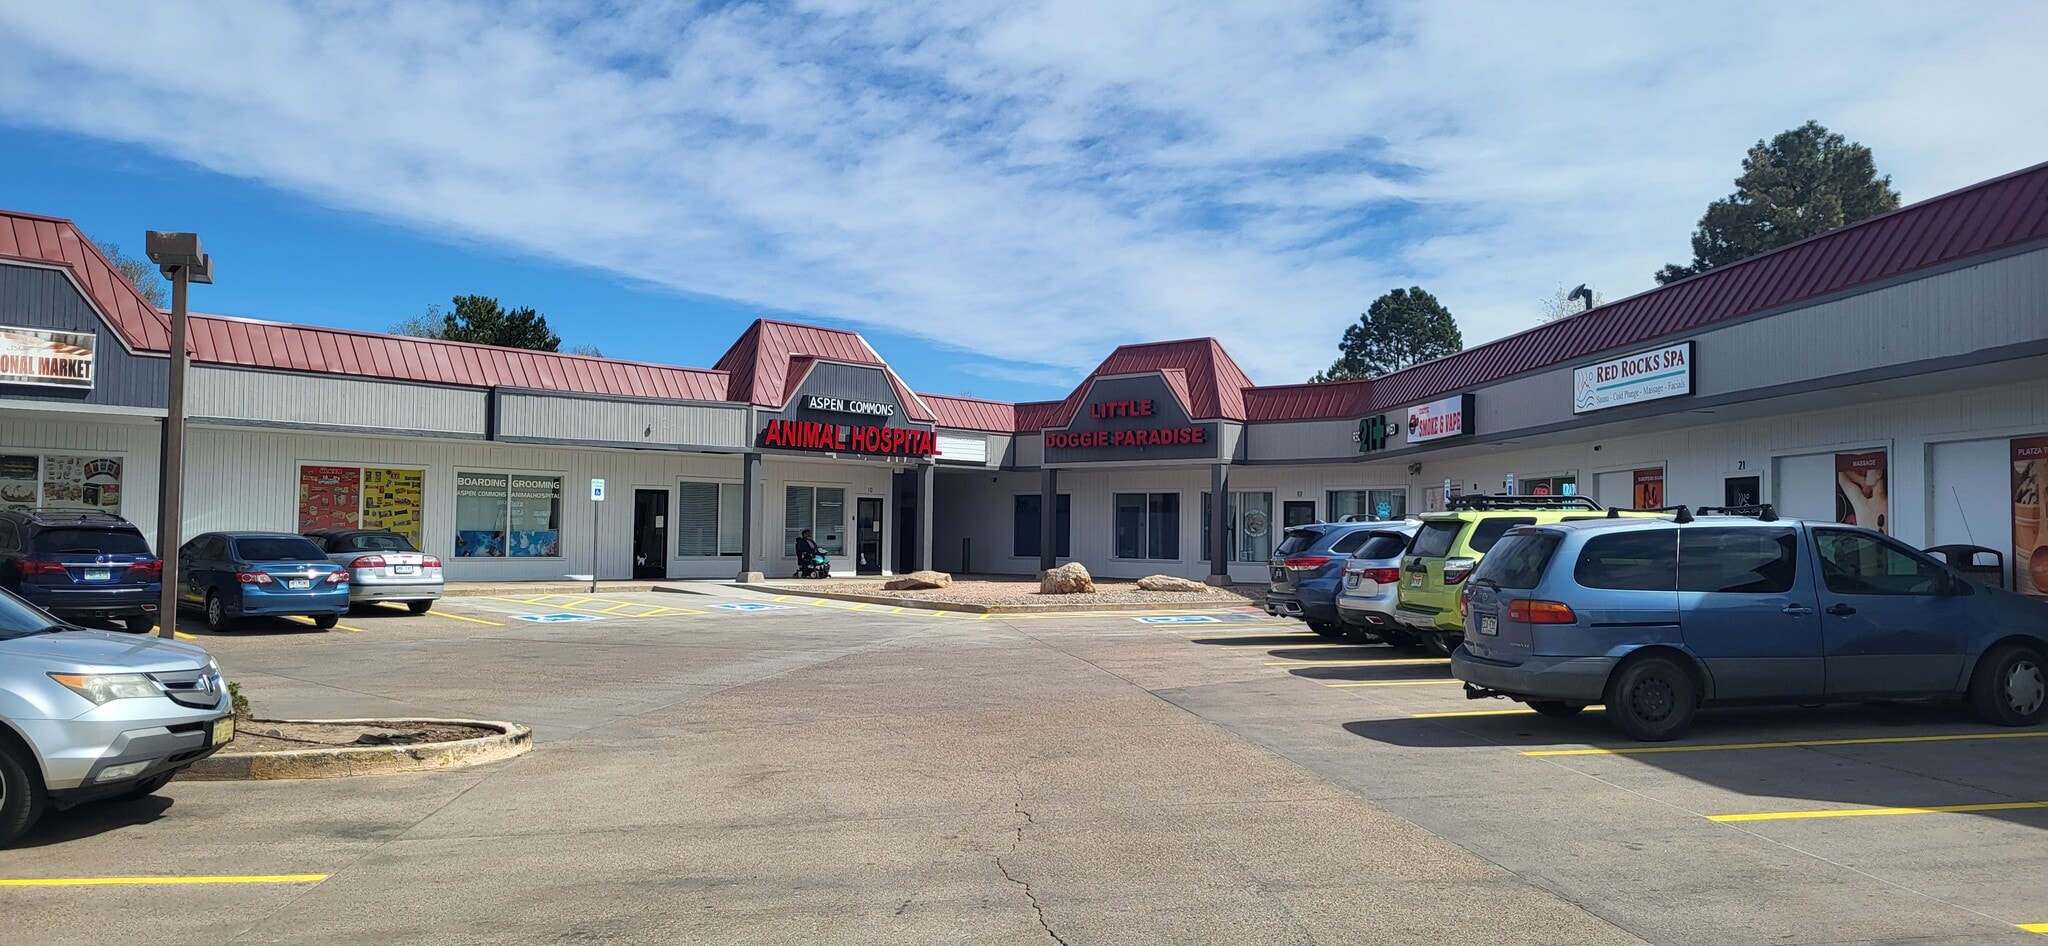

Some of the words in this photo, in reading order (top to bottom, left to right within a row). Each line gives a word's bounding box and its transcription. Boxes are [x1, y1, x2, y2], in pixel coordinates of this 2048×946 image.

[38, 357, 91, 378] MARKET
[1596, 365, 1618, 383] RED
[1621, 354, 1660, 378] ROCKS
[1663, 350, 1685, 369] SPA
[1612, 391, 1623, 401] Cold
[1624, 390, 1639, 400] Plunge
[1643, 386, 1663, 395] Massage
[1667, 380, 1686, 390] Facials
[809, 397, 844, 411] ASPEN
[850, 400, 894, 416] COMMONS
[1090, 400, 1151, 419] LITTLE
[1419, 417, 1438, 437] SMOKE
[1445, 412, 1461, 432] VAPE
[765, 419, 846, 450] ANIMAL
[852, 424, 942, 455] HOSPITAL
[1045, 431, 1109, 449] DOGGIE
[1114, 427, 1203, 446] PARADISE
[2018, 448, 2042, 456] PLATZA
[1738, 460, 1746, 470] 21
[1852, 459, 1877, 467] MASSAGE
[458, 477, 506, 487] BOARDING
[512, 480, 560, 489] GROOMING
